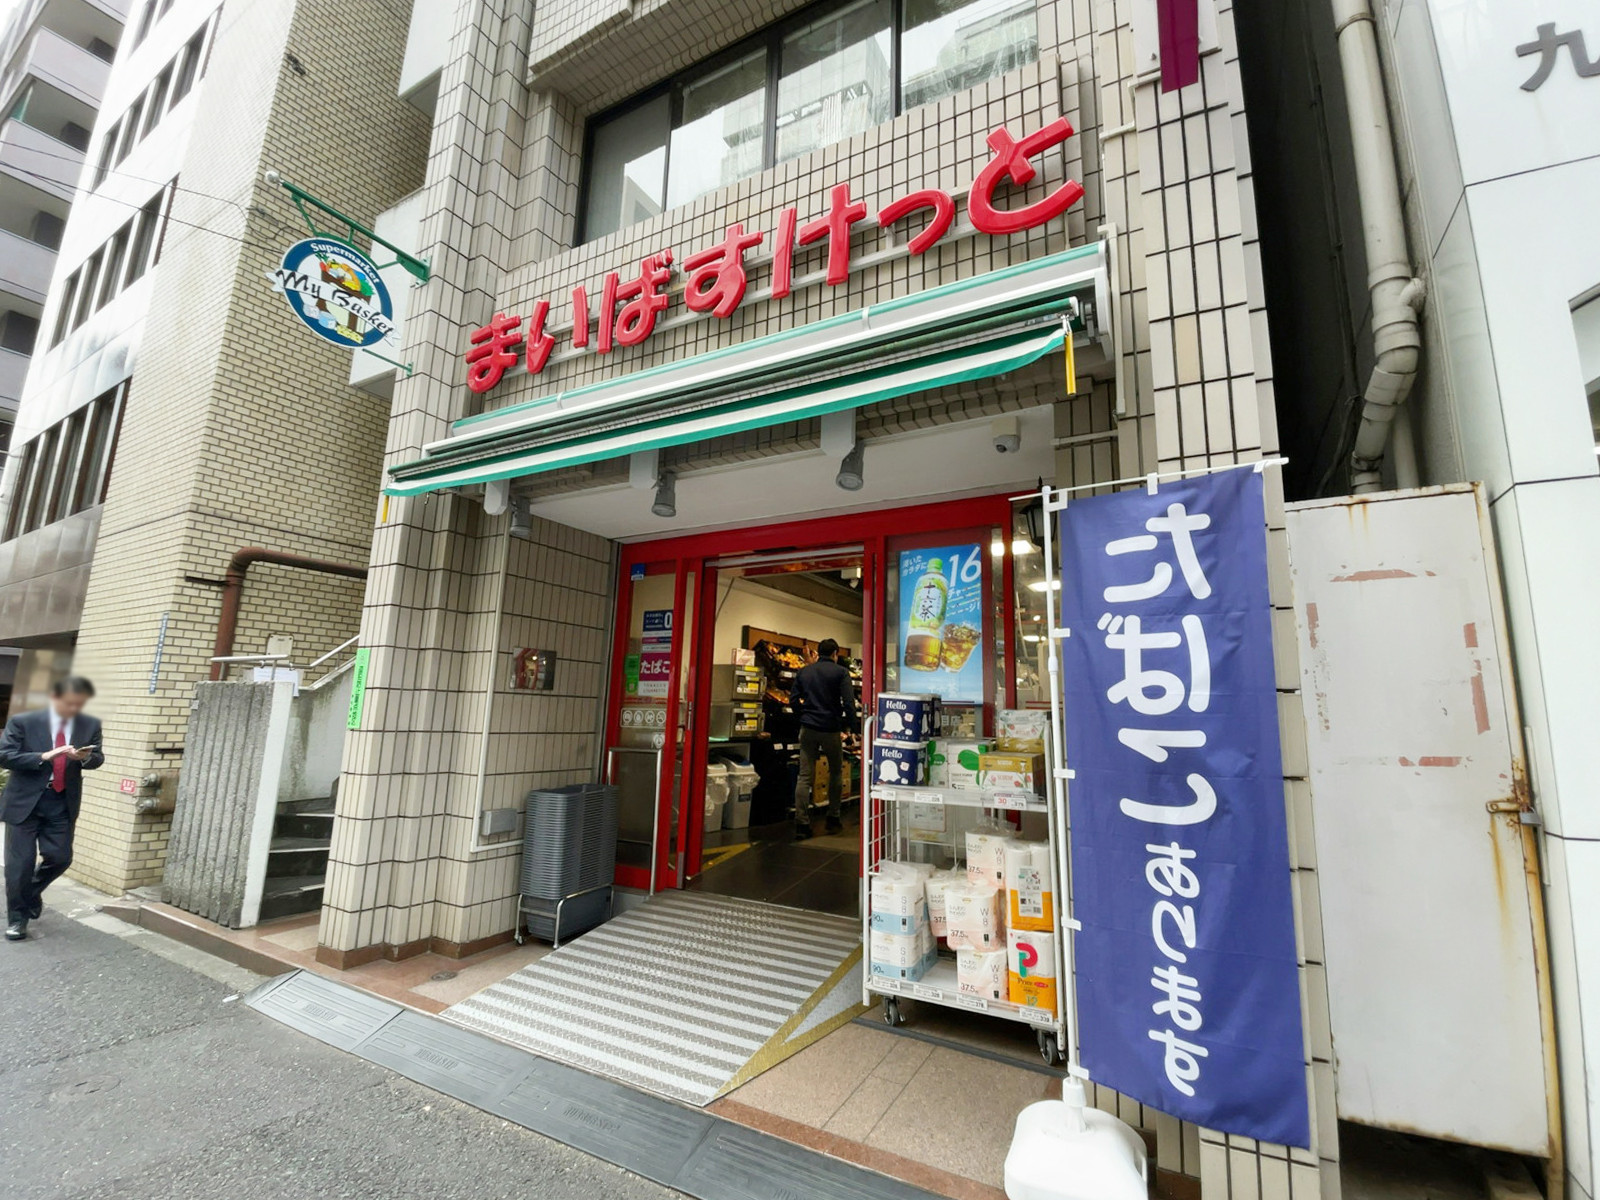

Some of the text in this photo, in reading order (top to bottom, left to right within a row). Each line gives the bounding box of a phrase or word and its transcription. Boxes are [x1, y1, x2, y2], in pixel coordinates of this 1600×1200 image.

[1515, 22, 1600, 92] 九
[310, 242, 380, 284] Supermarket
[465, 116, 1087, 395] まいばすけっと
[275, 269, 395, 336] My Basket
[948, 545, 981, 587] 16
[640, 659, 670, 674] たばこ
[886, 700, 907, 711] Hello
[881, 748, 903, 759] Hello
